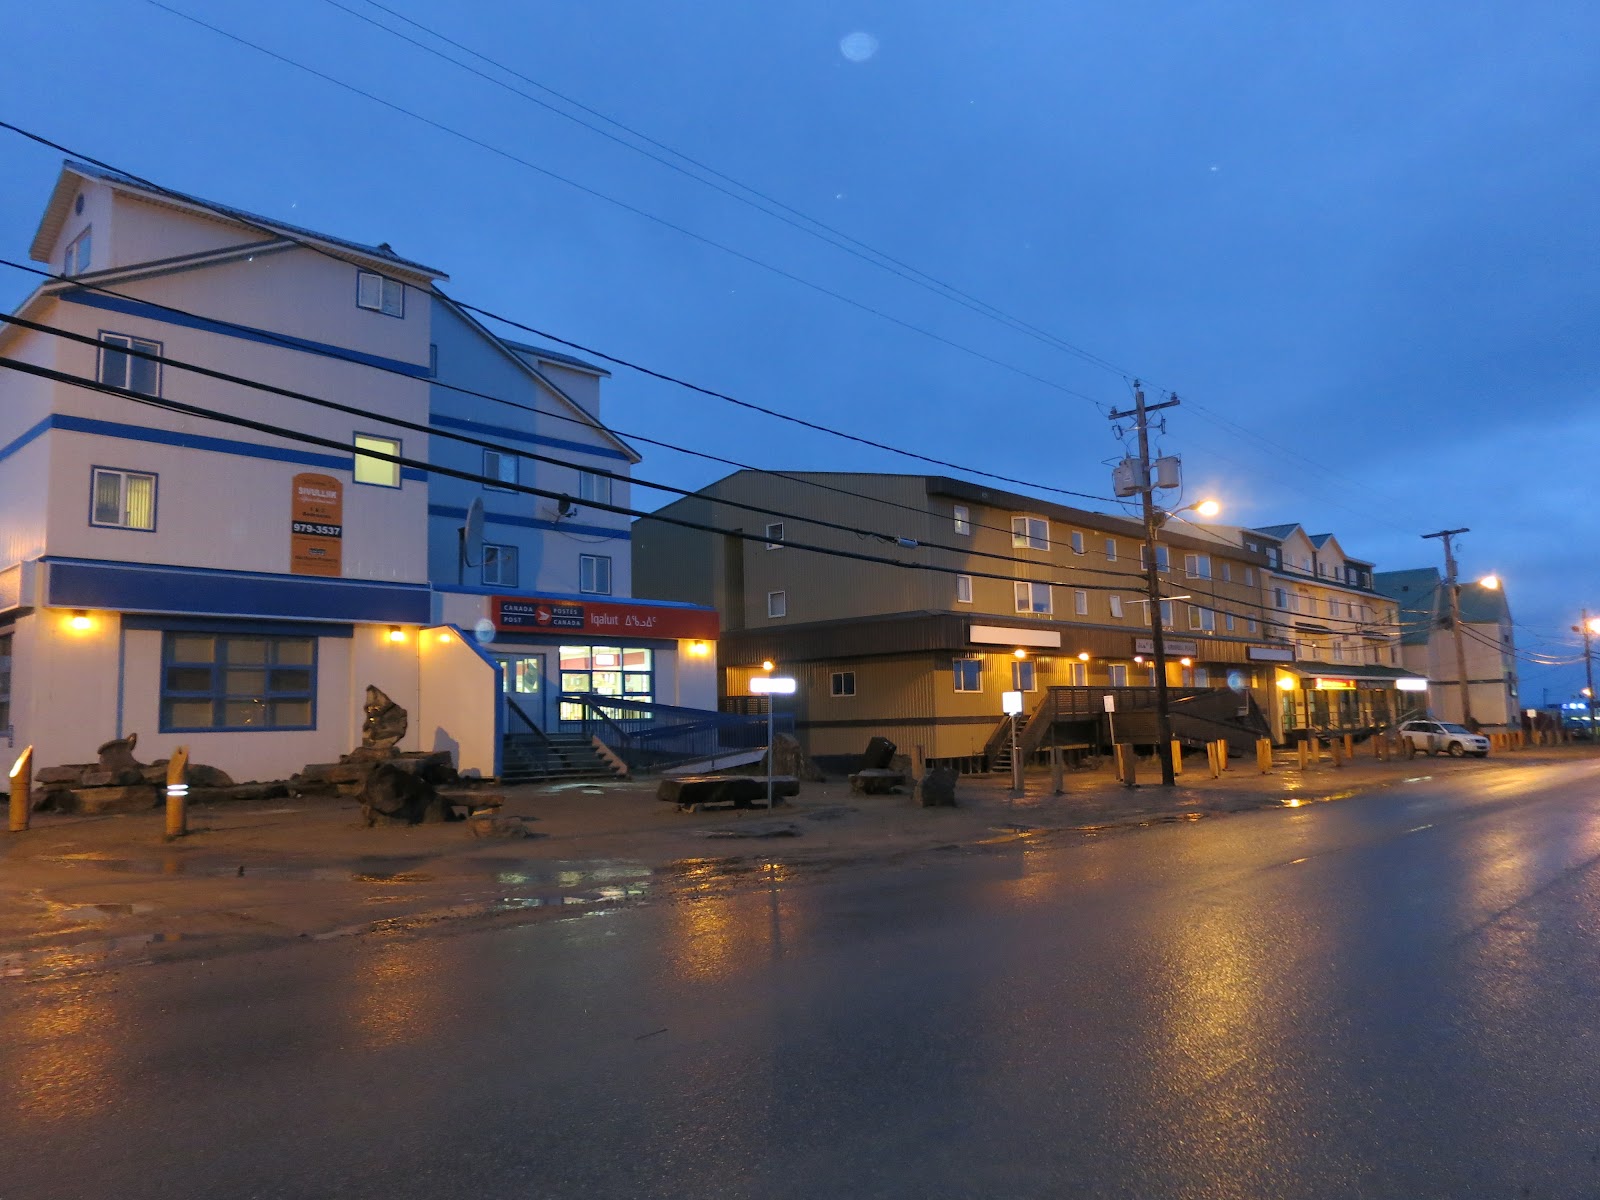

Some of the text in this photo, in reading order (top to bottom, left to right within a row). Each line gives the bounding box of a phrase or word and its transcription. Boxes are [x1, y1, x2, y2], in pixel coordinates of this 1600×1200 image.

[293, 523, 340, 535] 979-3537
[503, 604, 533, 612] CANADA
[590, 612, 619, 627] Iqaluit
